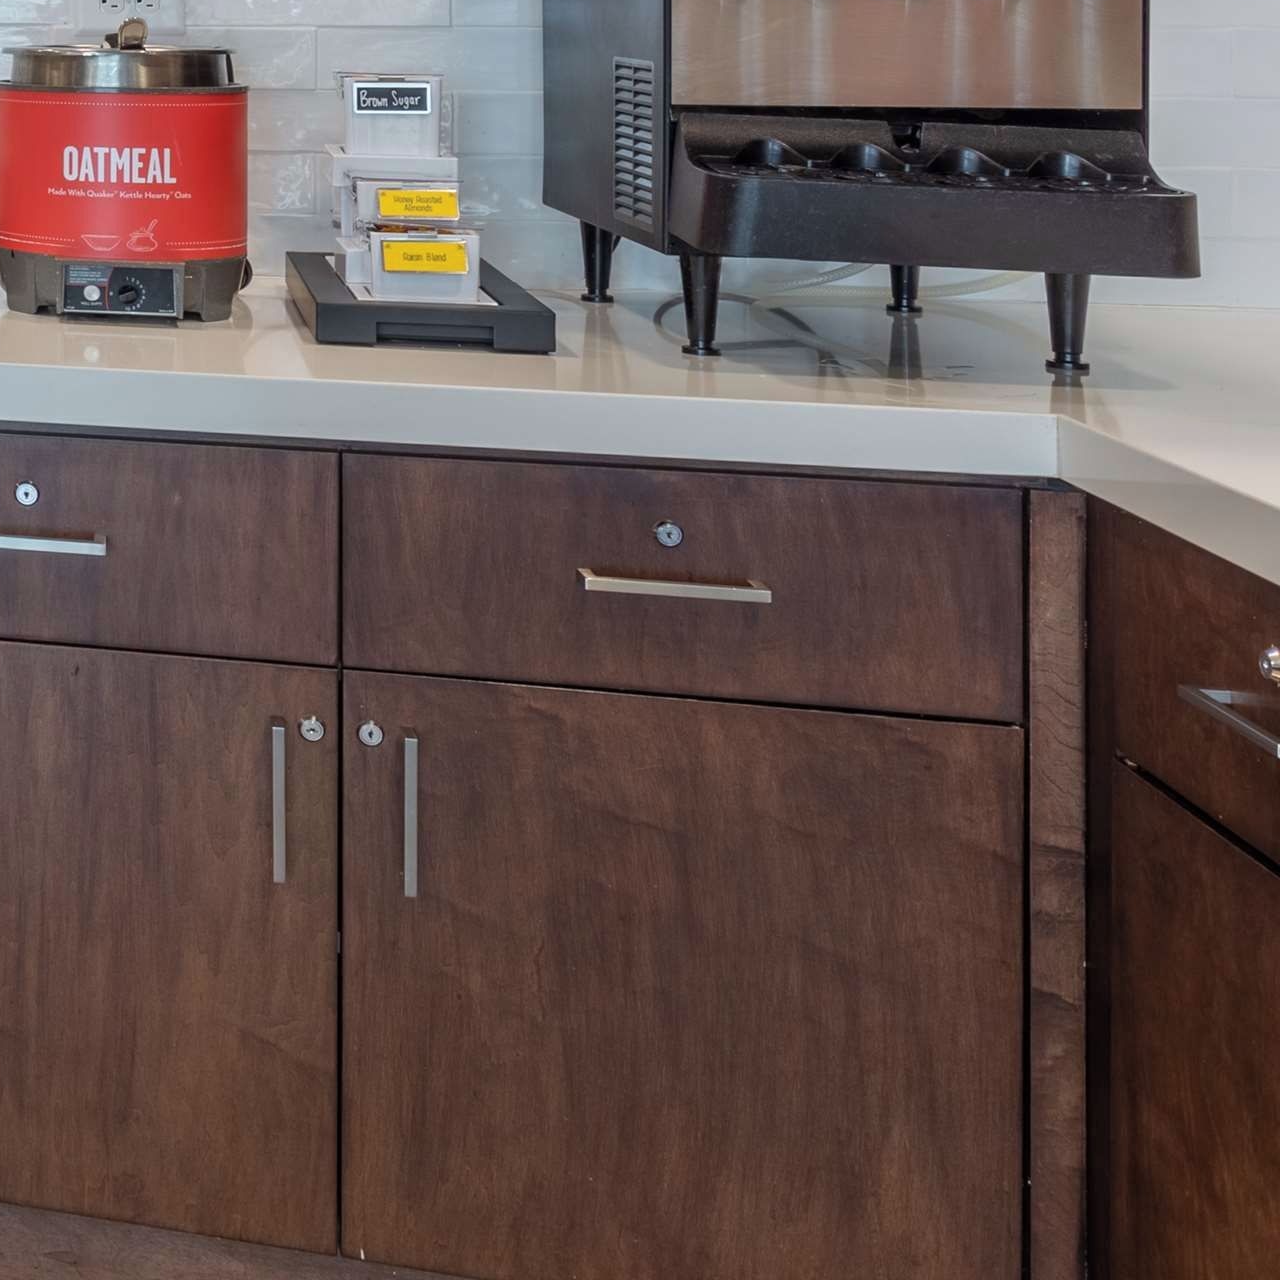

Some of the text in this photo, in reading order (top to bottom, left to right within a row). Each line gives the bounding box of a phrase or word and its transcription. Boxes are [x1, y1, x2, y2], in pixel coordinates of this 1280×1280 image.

[359, 89, 421, 109] Brown Sugar
[63, 145, 177, 184] OATMEAL
[47, 187, 67, 196] Made
[67, 188, 86, 197] With
[119, 191, 143, 199] Kettle
[174, 191, 192, 199] Oats
